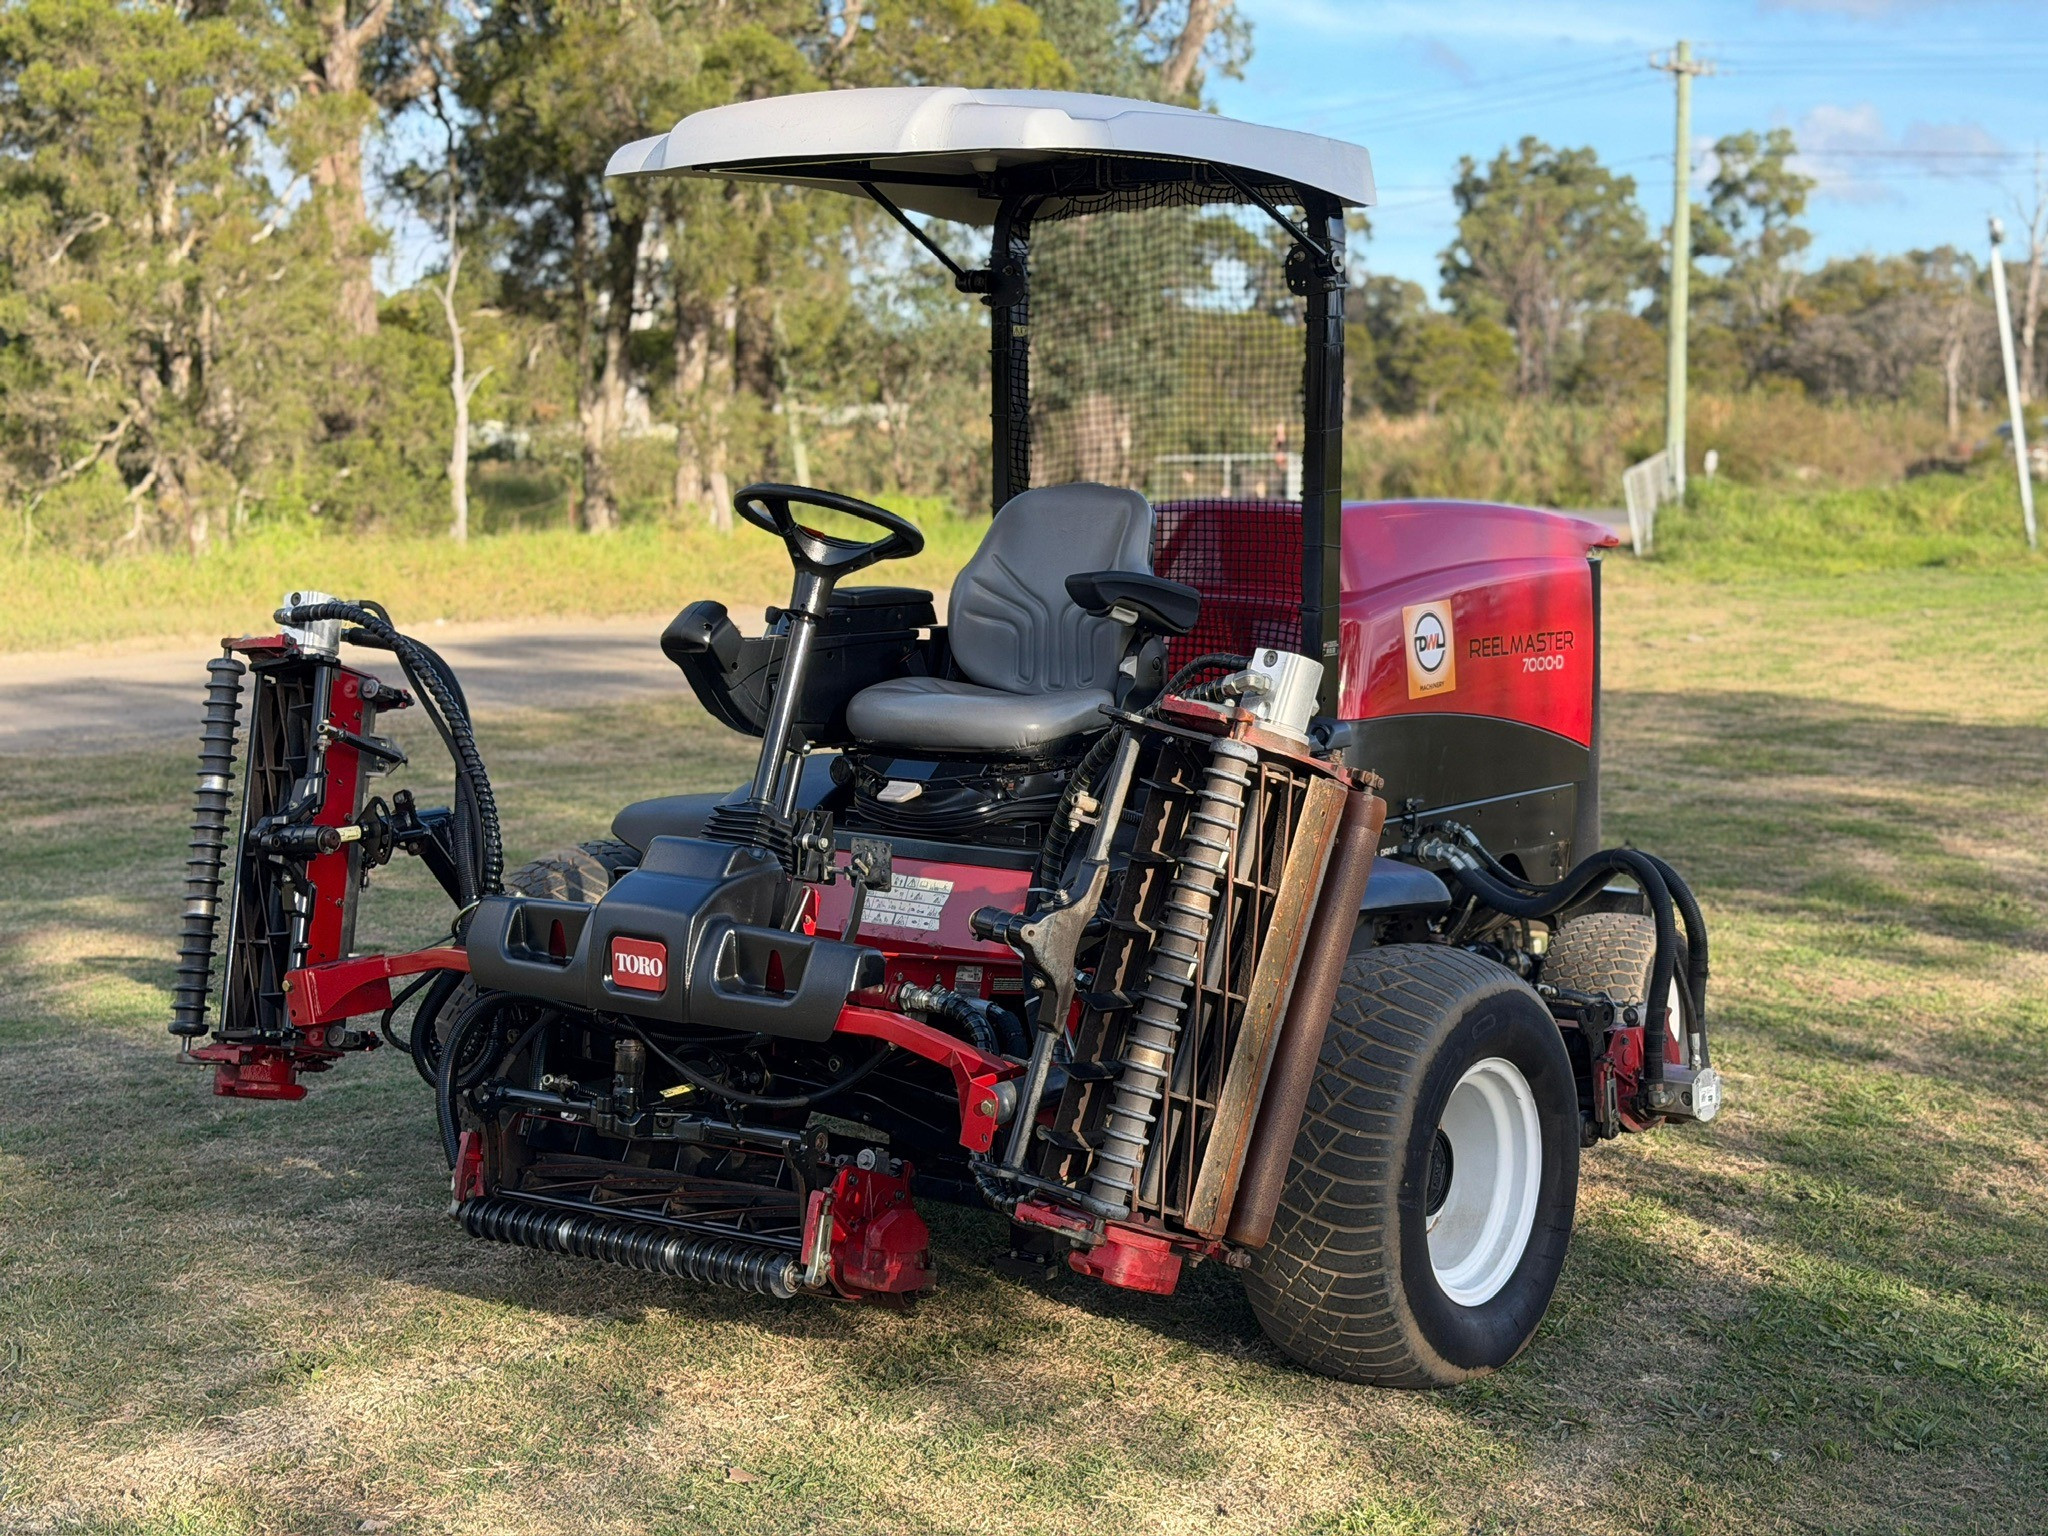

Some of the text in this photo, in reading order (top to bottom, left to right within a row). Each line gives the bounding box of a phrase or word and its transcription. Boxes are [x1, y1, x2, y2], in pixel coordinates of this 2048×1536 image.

[1469, 630, 1574, 658] REELMASTER
[1420, 681, 1445, 691] MACHINERY
[615, 952, 663, 977] TORO
